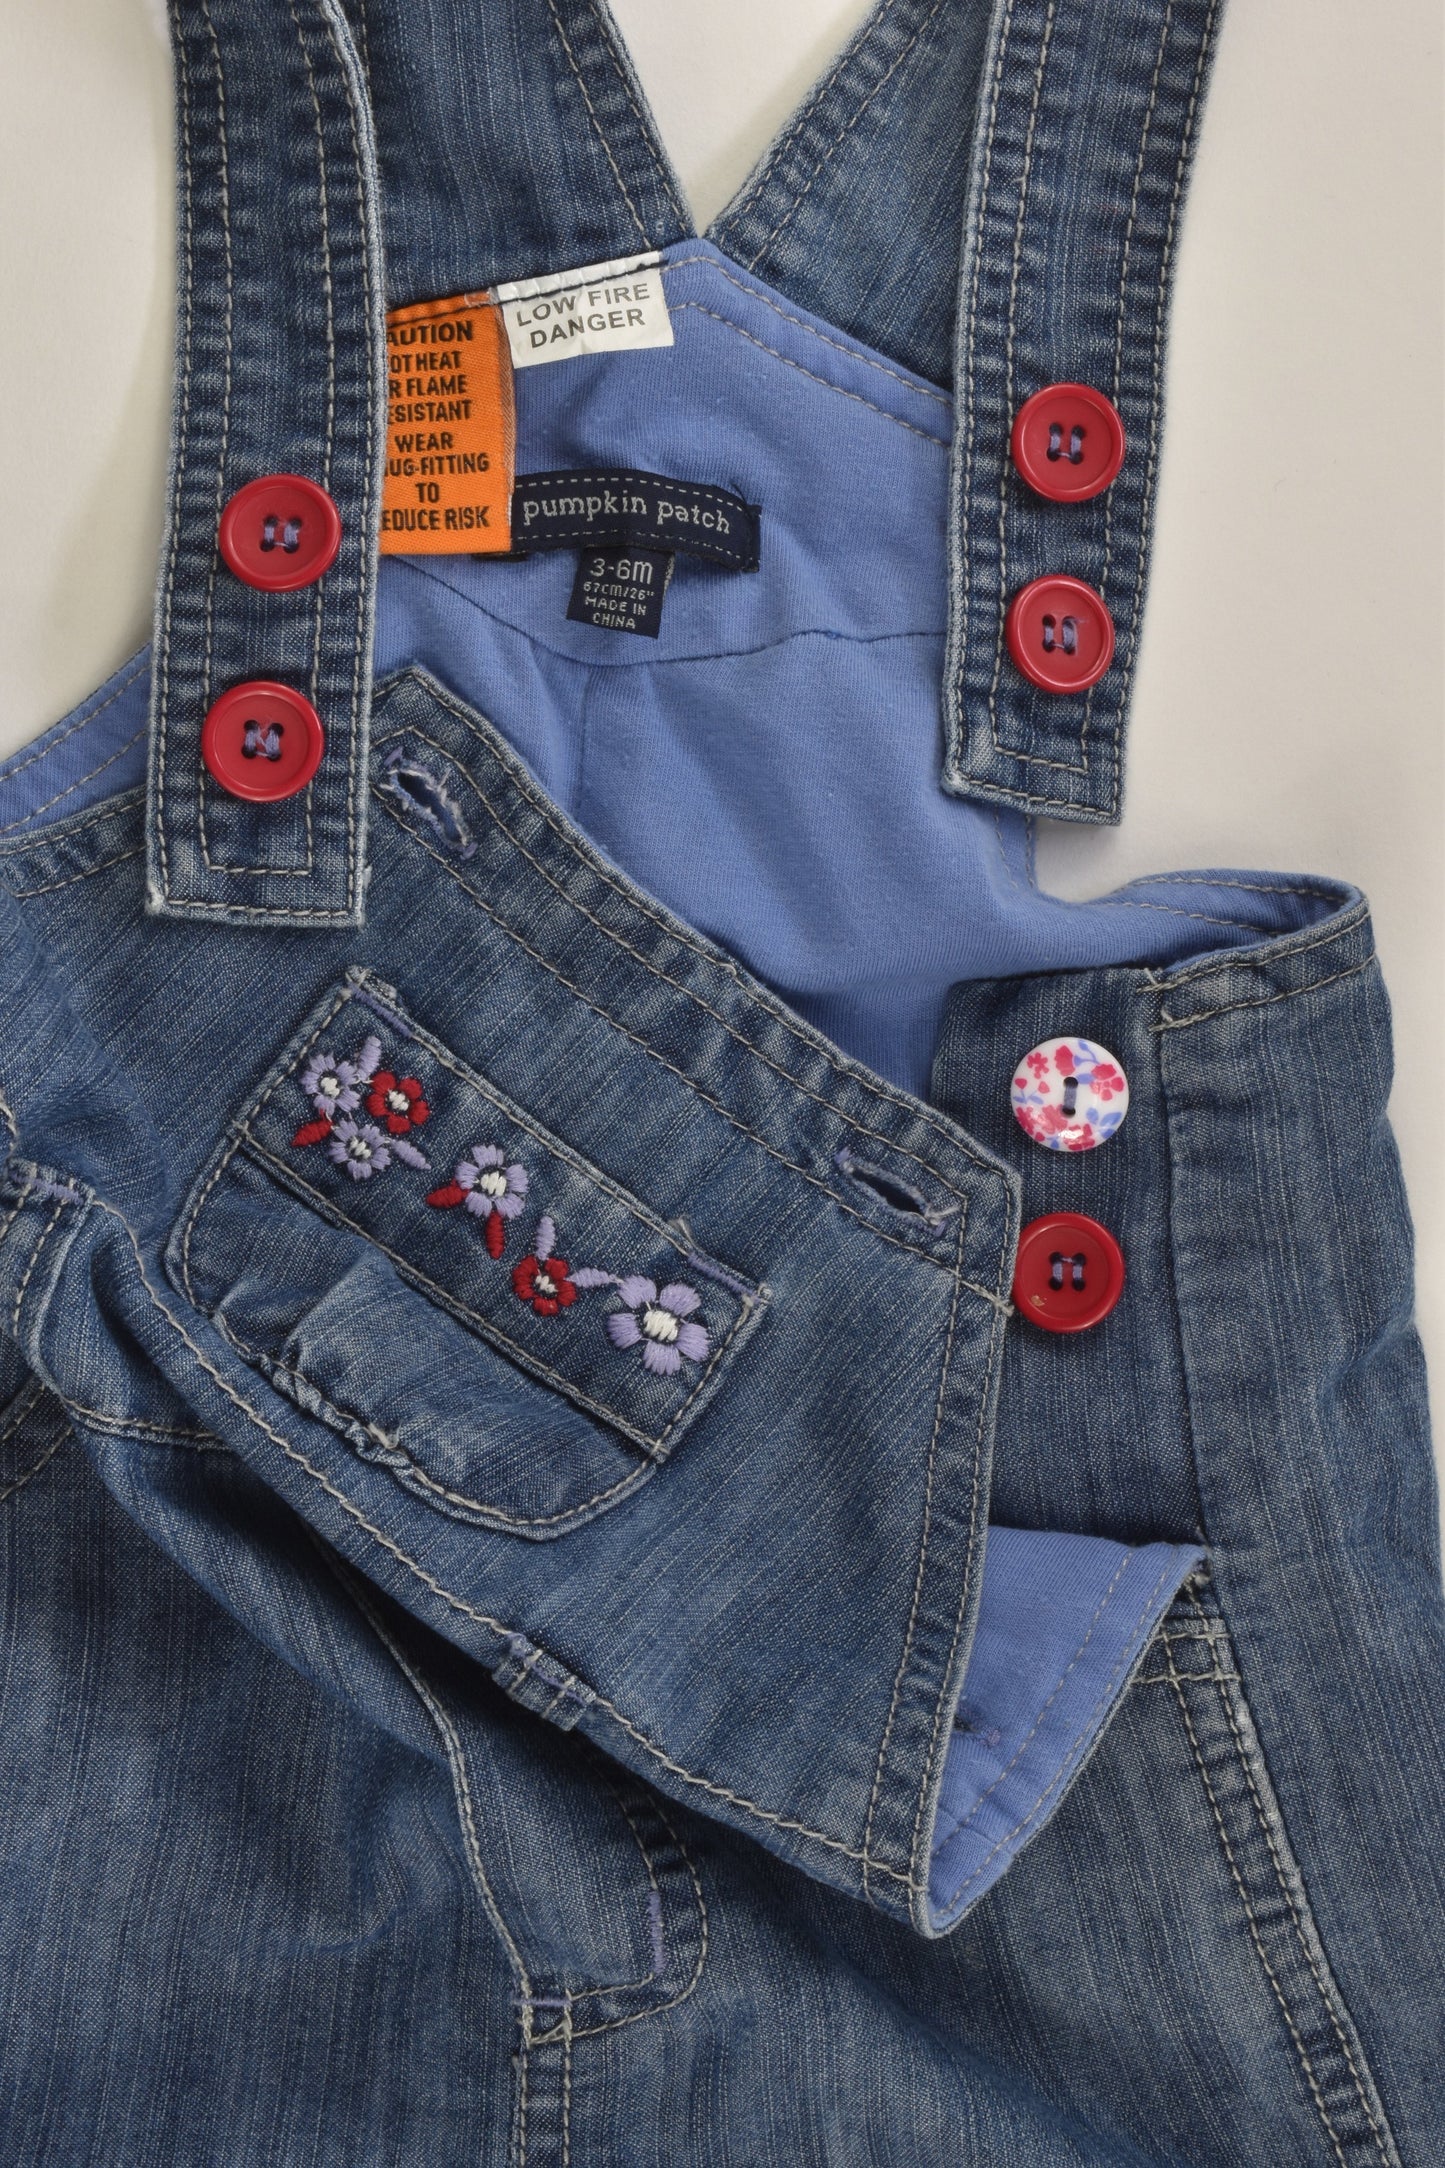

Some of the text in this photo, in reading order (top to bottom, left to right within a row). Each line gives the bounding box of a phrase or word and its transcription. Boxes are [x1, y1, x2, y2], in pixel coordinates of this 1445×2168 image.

[516, 283, 650, 327] LOW FIRE
[386, 320, 473, 346] AUTION
[530, 308, 646, 348] DANGER
[389, 351, 462, 373] OT HEAT
[388, 374, 467, 399] R FLAME
[388, 400, 471, 424] ESISTANT
[395, 432, 454, 452] WEAR
[384, 453, 490, 477] UG-FITTING
[415, 482, 440, 503] TO
[382, 506, 490, 531] EDUCE RISK
[523, 490, 730, 535] pumpkin patch
[585, 596, 647, 616] MADE IN
[593, 612, 636, 629] CHINA
